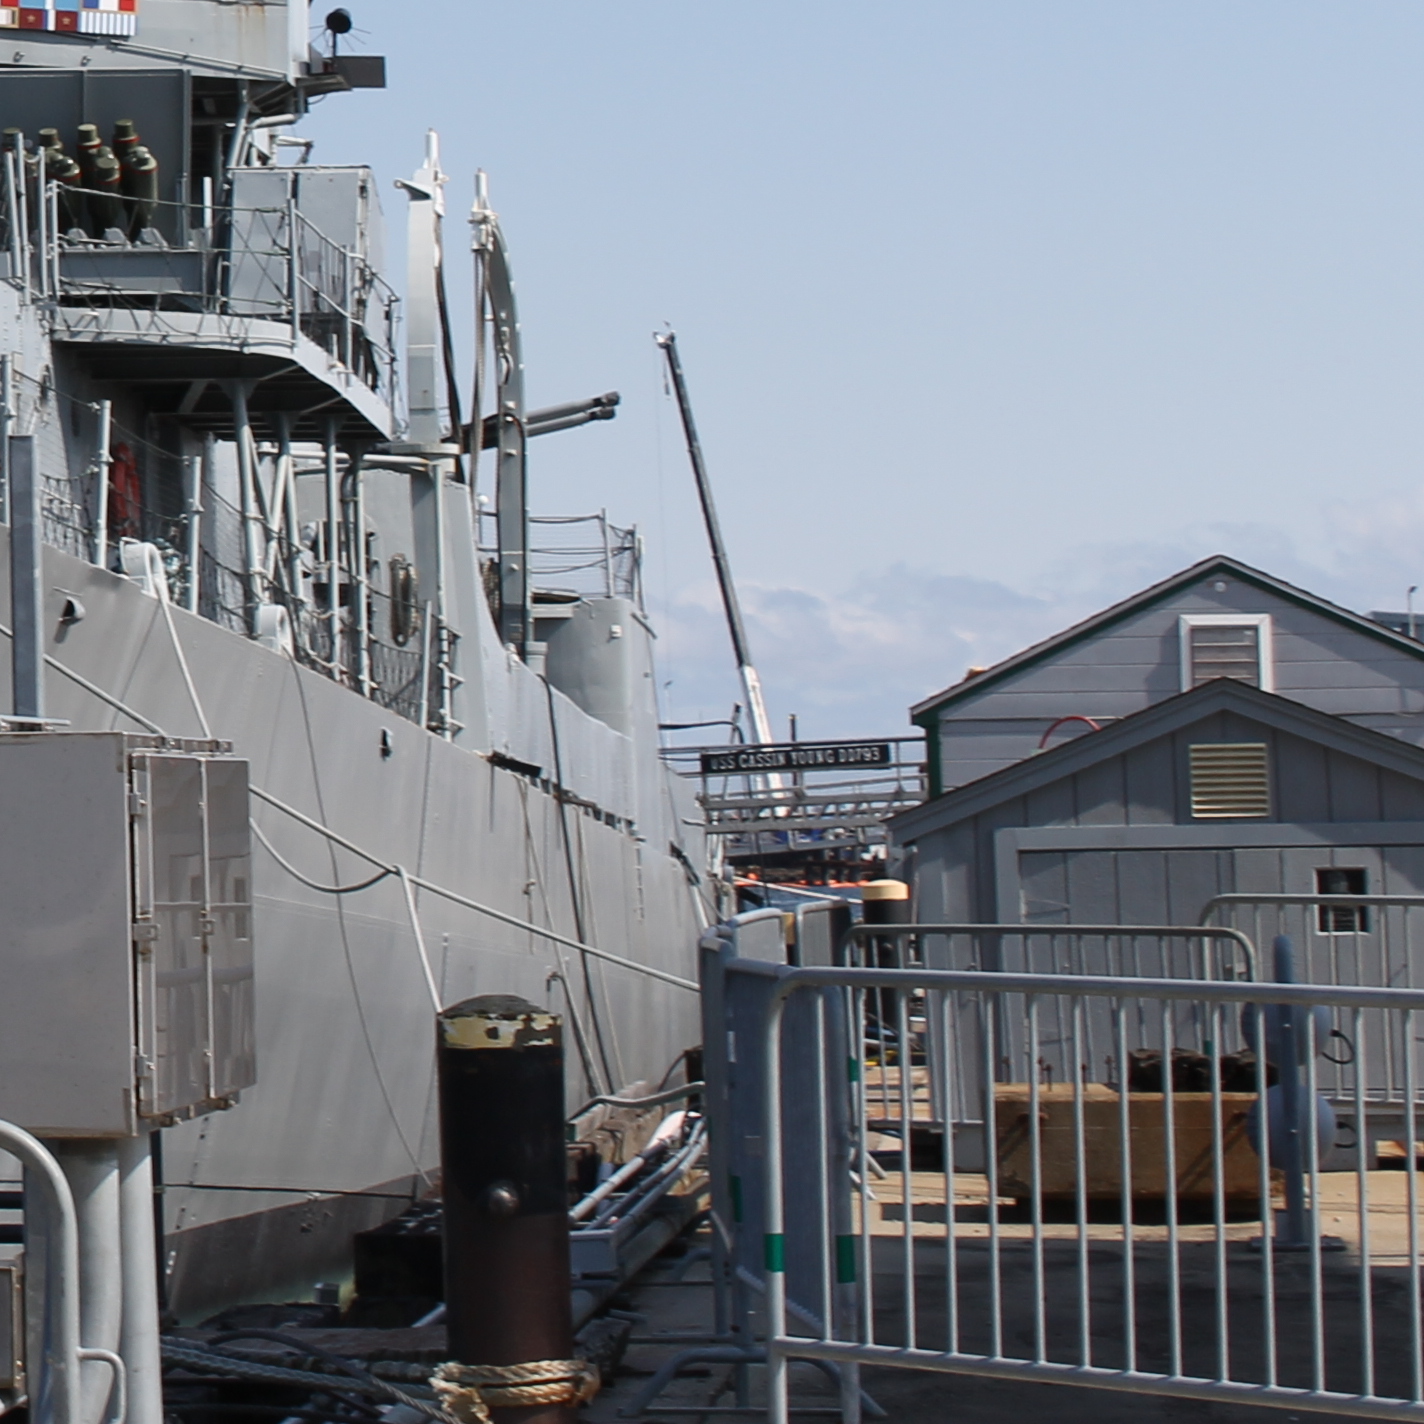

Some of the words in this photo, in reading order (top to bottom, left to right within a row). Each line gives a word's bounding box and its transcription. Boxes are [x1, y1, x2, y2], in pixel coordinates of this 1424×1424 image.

[710, 754, 736, 770] USS
[738, 751, 787, 768] CASSIN
[790, 749, 835, 766] YOUNG
